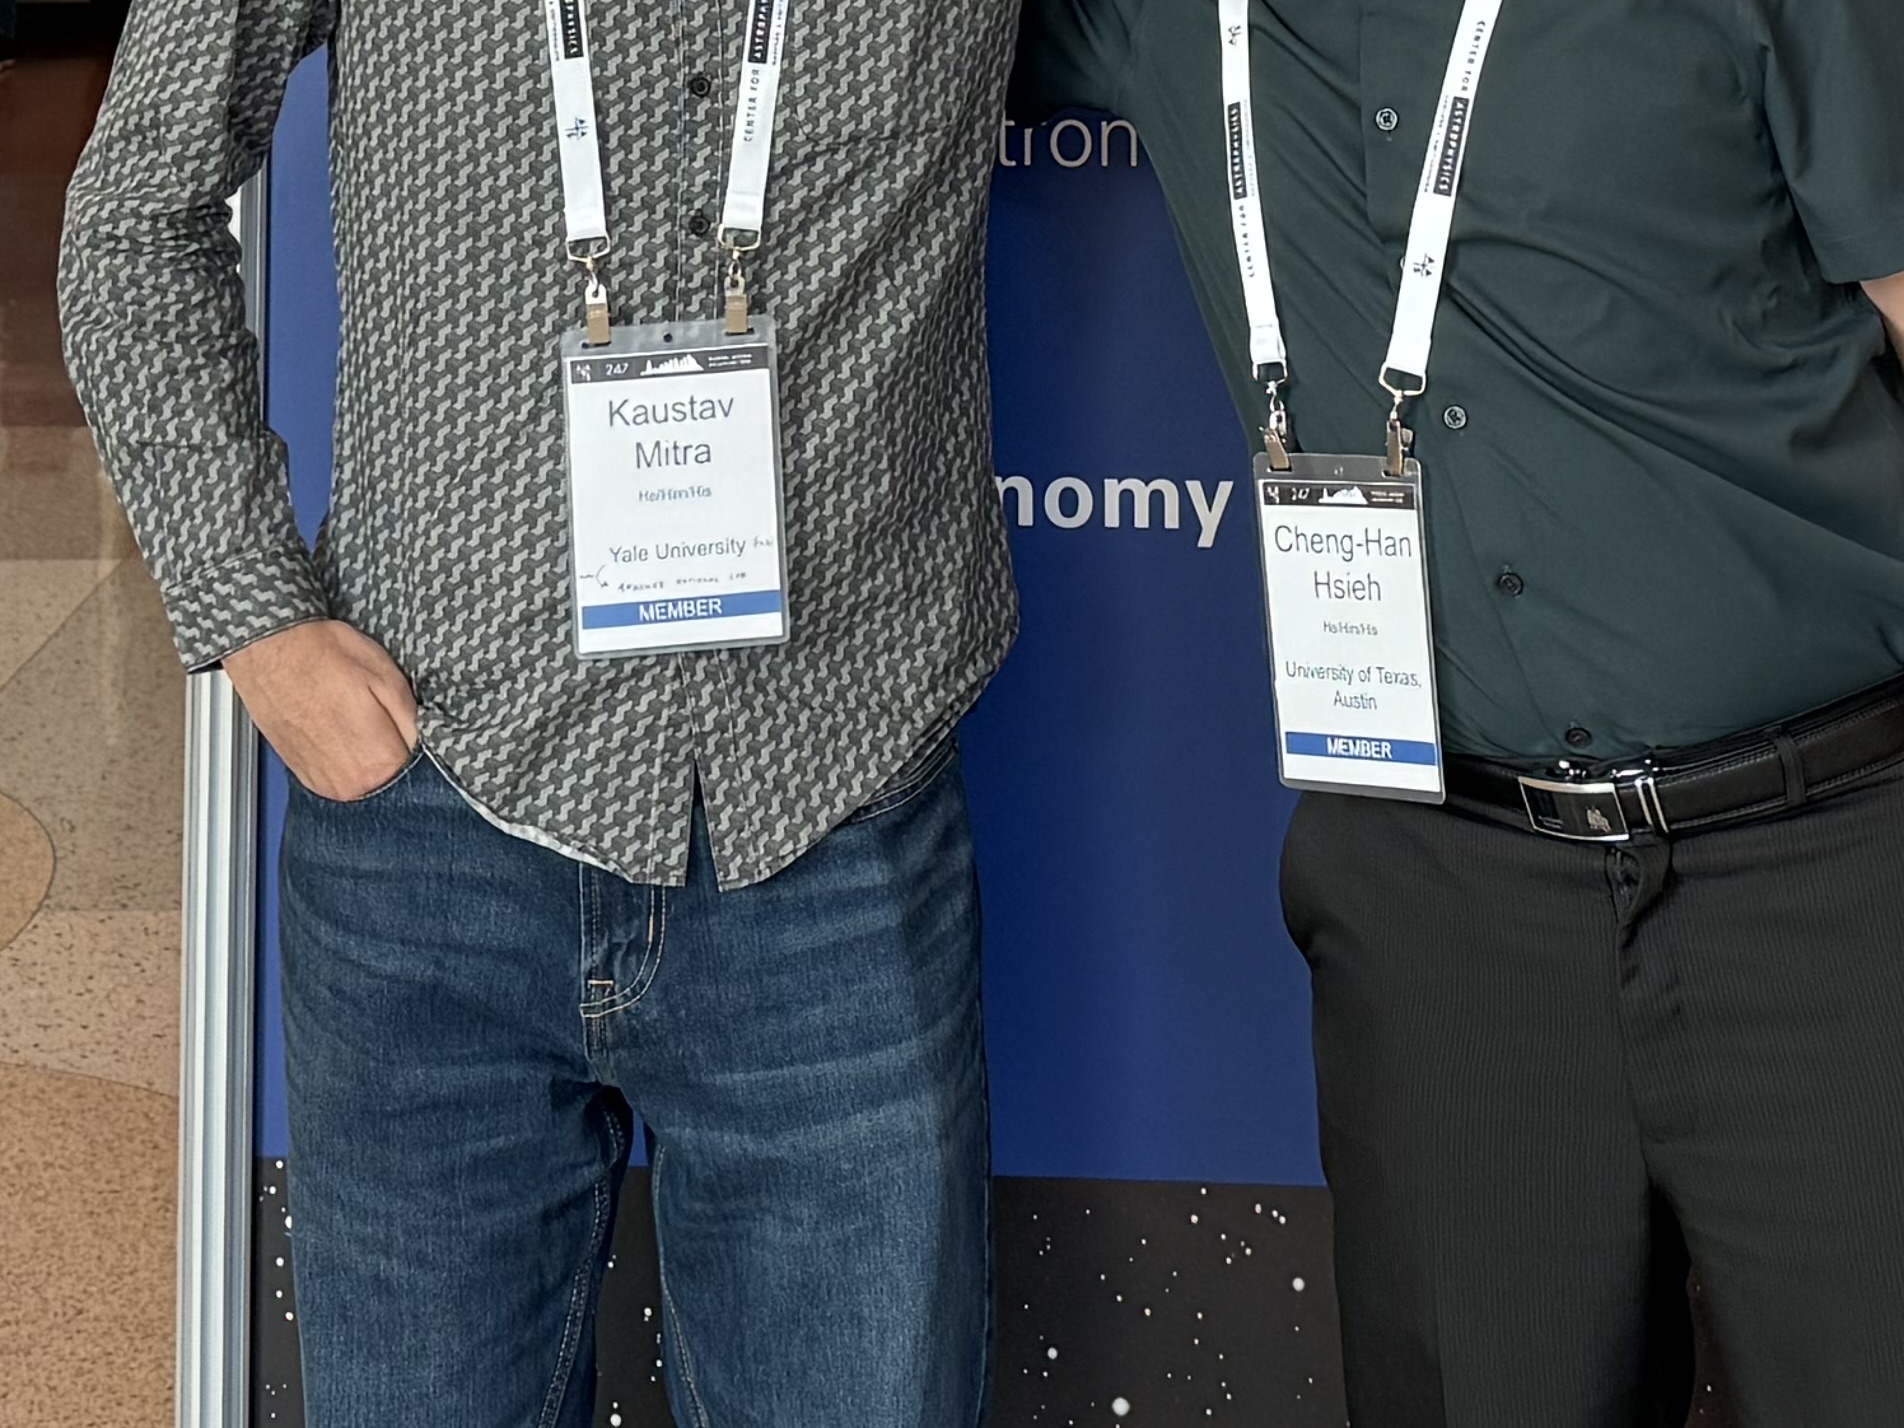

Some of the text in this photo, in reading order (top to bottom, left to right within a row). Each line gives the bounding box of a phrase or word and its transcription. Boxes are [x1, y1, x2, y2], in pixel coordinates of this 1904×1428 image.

[609, 396, 733, 427] Kaustav
[636, 440, 711, 469] Mitra
[610, 546, 648, 563] Yale
[656, 538, 746, 559] University
[1275, 525, 1411, 562] Cheng-Han
[1314, 571, 1381, 601] Hsieh
[640, 599, 722, 620] MEMBER
[1286, 661, 1353, 685] University
[1358, 666, 1371, 682] of
[1334, 690, 1377, 709] Austin
[1327, 738, 1391, 758] MEMBER
